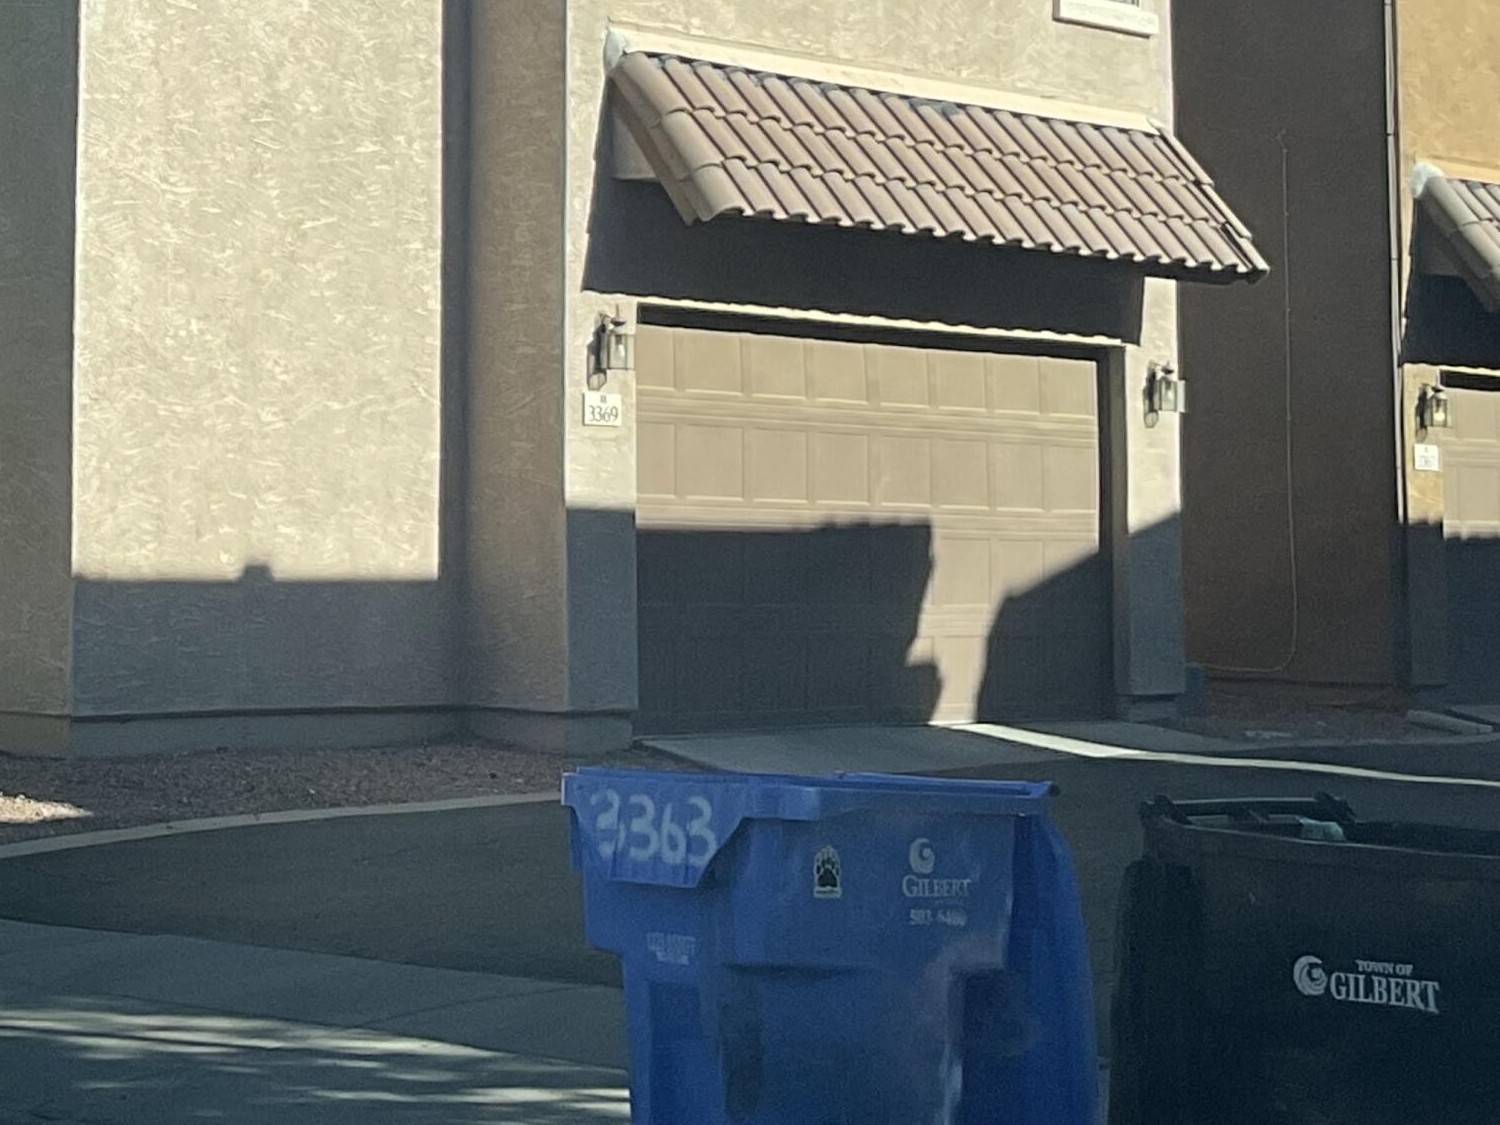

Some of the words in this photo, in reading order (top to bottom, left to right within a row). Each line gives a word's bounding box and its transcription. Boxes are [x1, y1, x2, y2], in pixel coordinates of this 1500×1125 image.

[587, 404, 619, 423] 3369
[902, 874, 973, 898] GILBERT
[1355, 959, 1394, 974] TOWN
[1395, 964, 1414, 976] OF
[1329, 971, 1441, 1014] GILBERT
